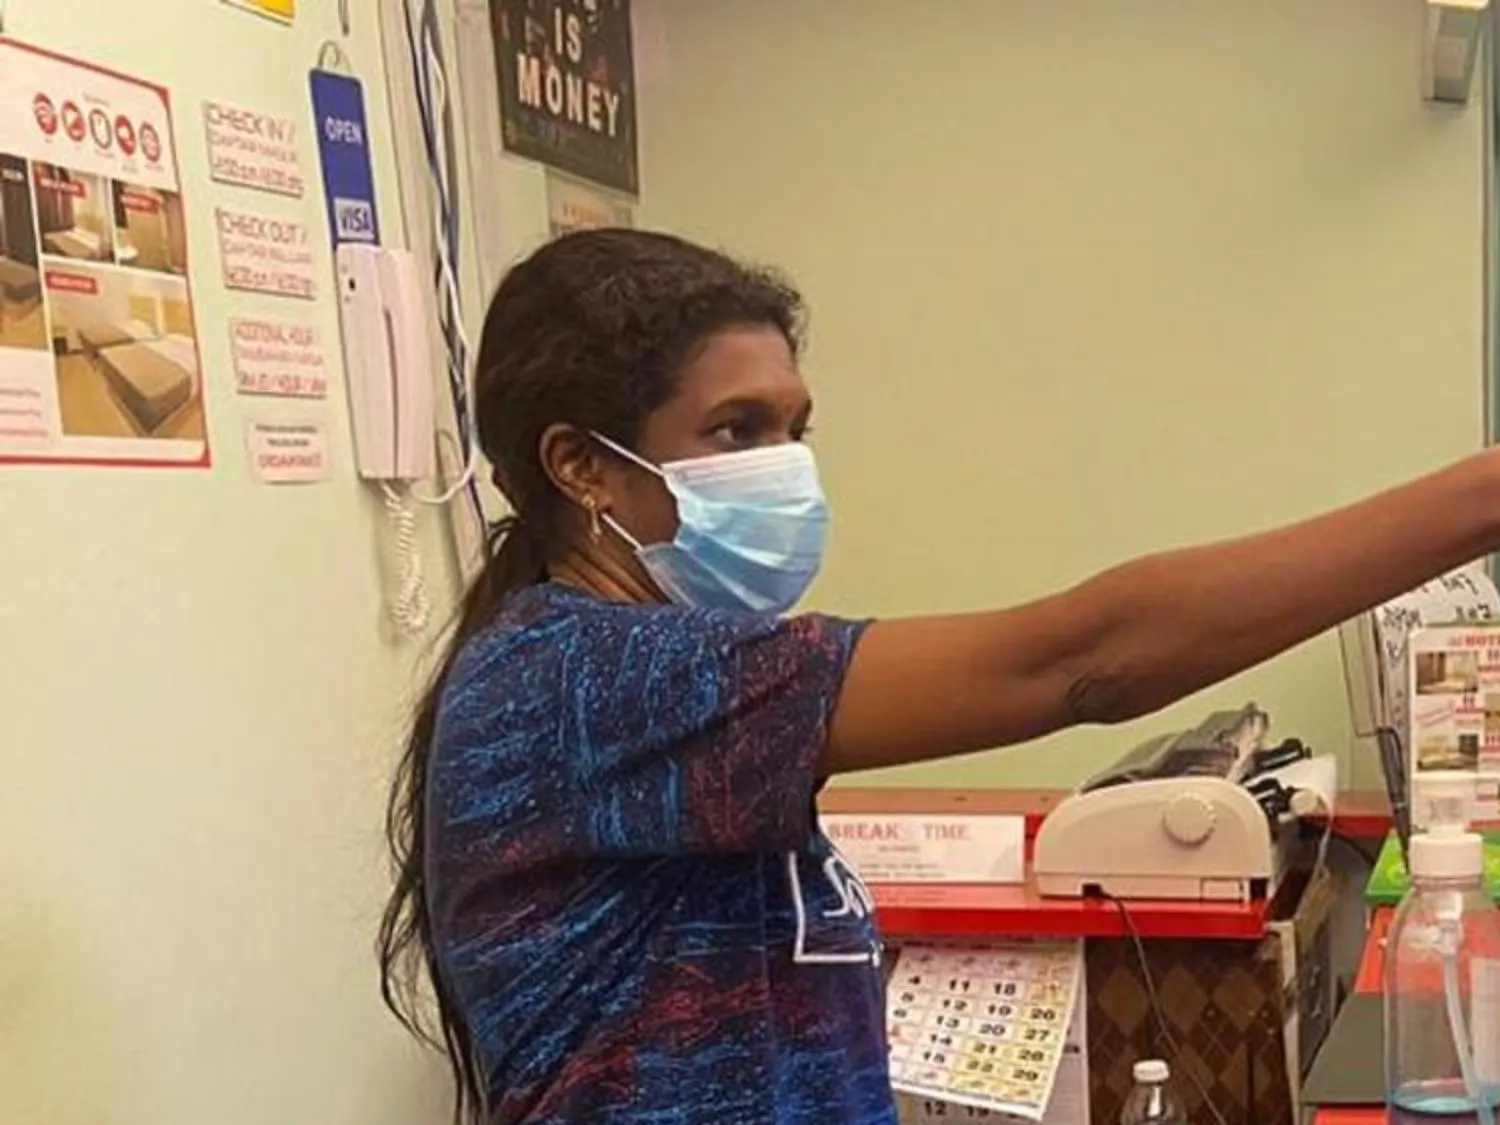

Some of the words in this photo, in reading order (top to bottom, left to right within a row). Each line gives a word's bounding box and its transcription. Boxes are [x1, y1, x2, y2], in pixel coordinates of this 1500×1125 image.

[555, 7, 582, 63] IS
[517, 52, 619, 138] MONEY
[207, 102, 264, 136] CHECK
[325, 115, 362, 144] OPEN
[221, 210, 268, 240] CHECK
[340, 206, 372, 232] VISA
[829, 822, 901, 841] BREAK
[922, 822, 971, 841] TIME
[950, 978, 971, 993] 11
[994, 982, 1017, 997] 18
[942, 999, 968, 1012] 12
[1031, 1008, 1056, 1022] 26
[936, 1015, 960, 1029] 13
[979, 1024, 1006, 1037] 20
[1024, 1029, 1050, 1042] 27
[930, 1033, 953, 1046] 14
[973, 1043, 998, 1055] 21
[966, 1059, 994, 1073] 22
[1012, 1069, 1039, 1082] 29
[924, 1100, 948, 1116] 12
